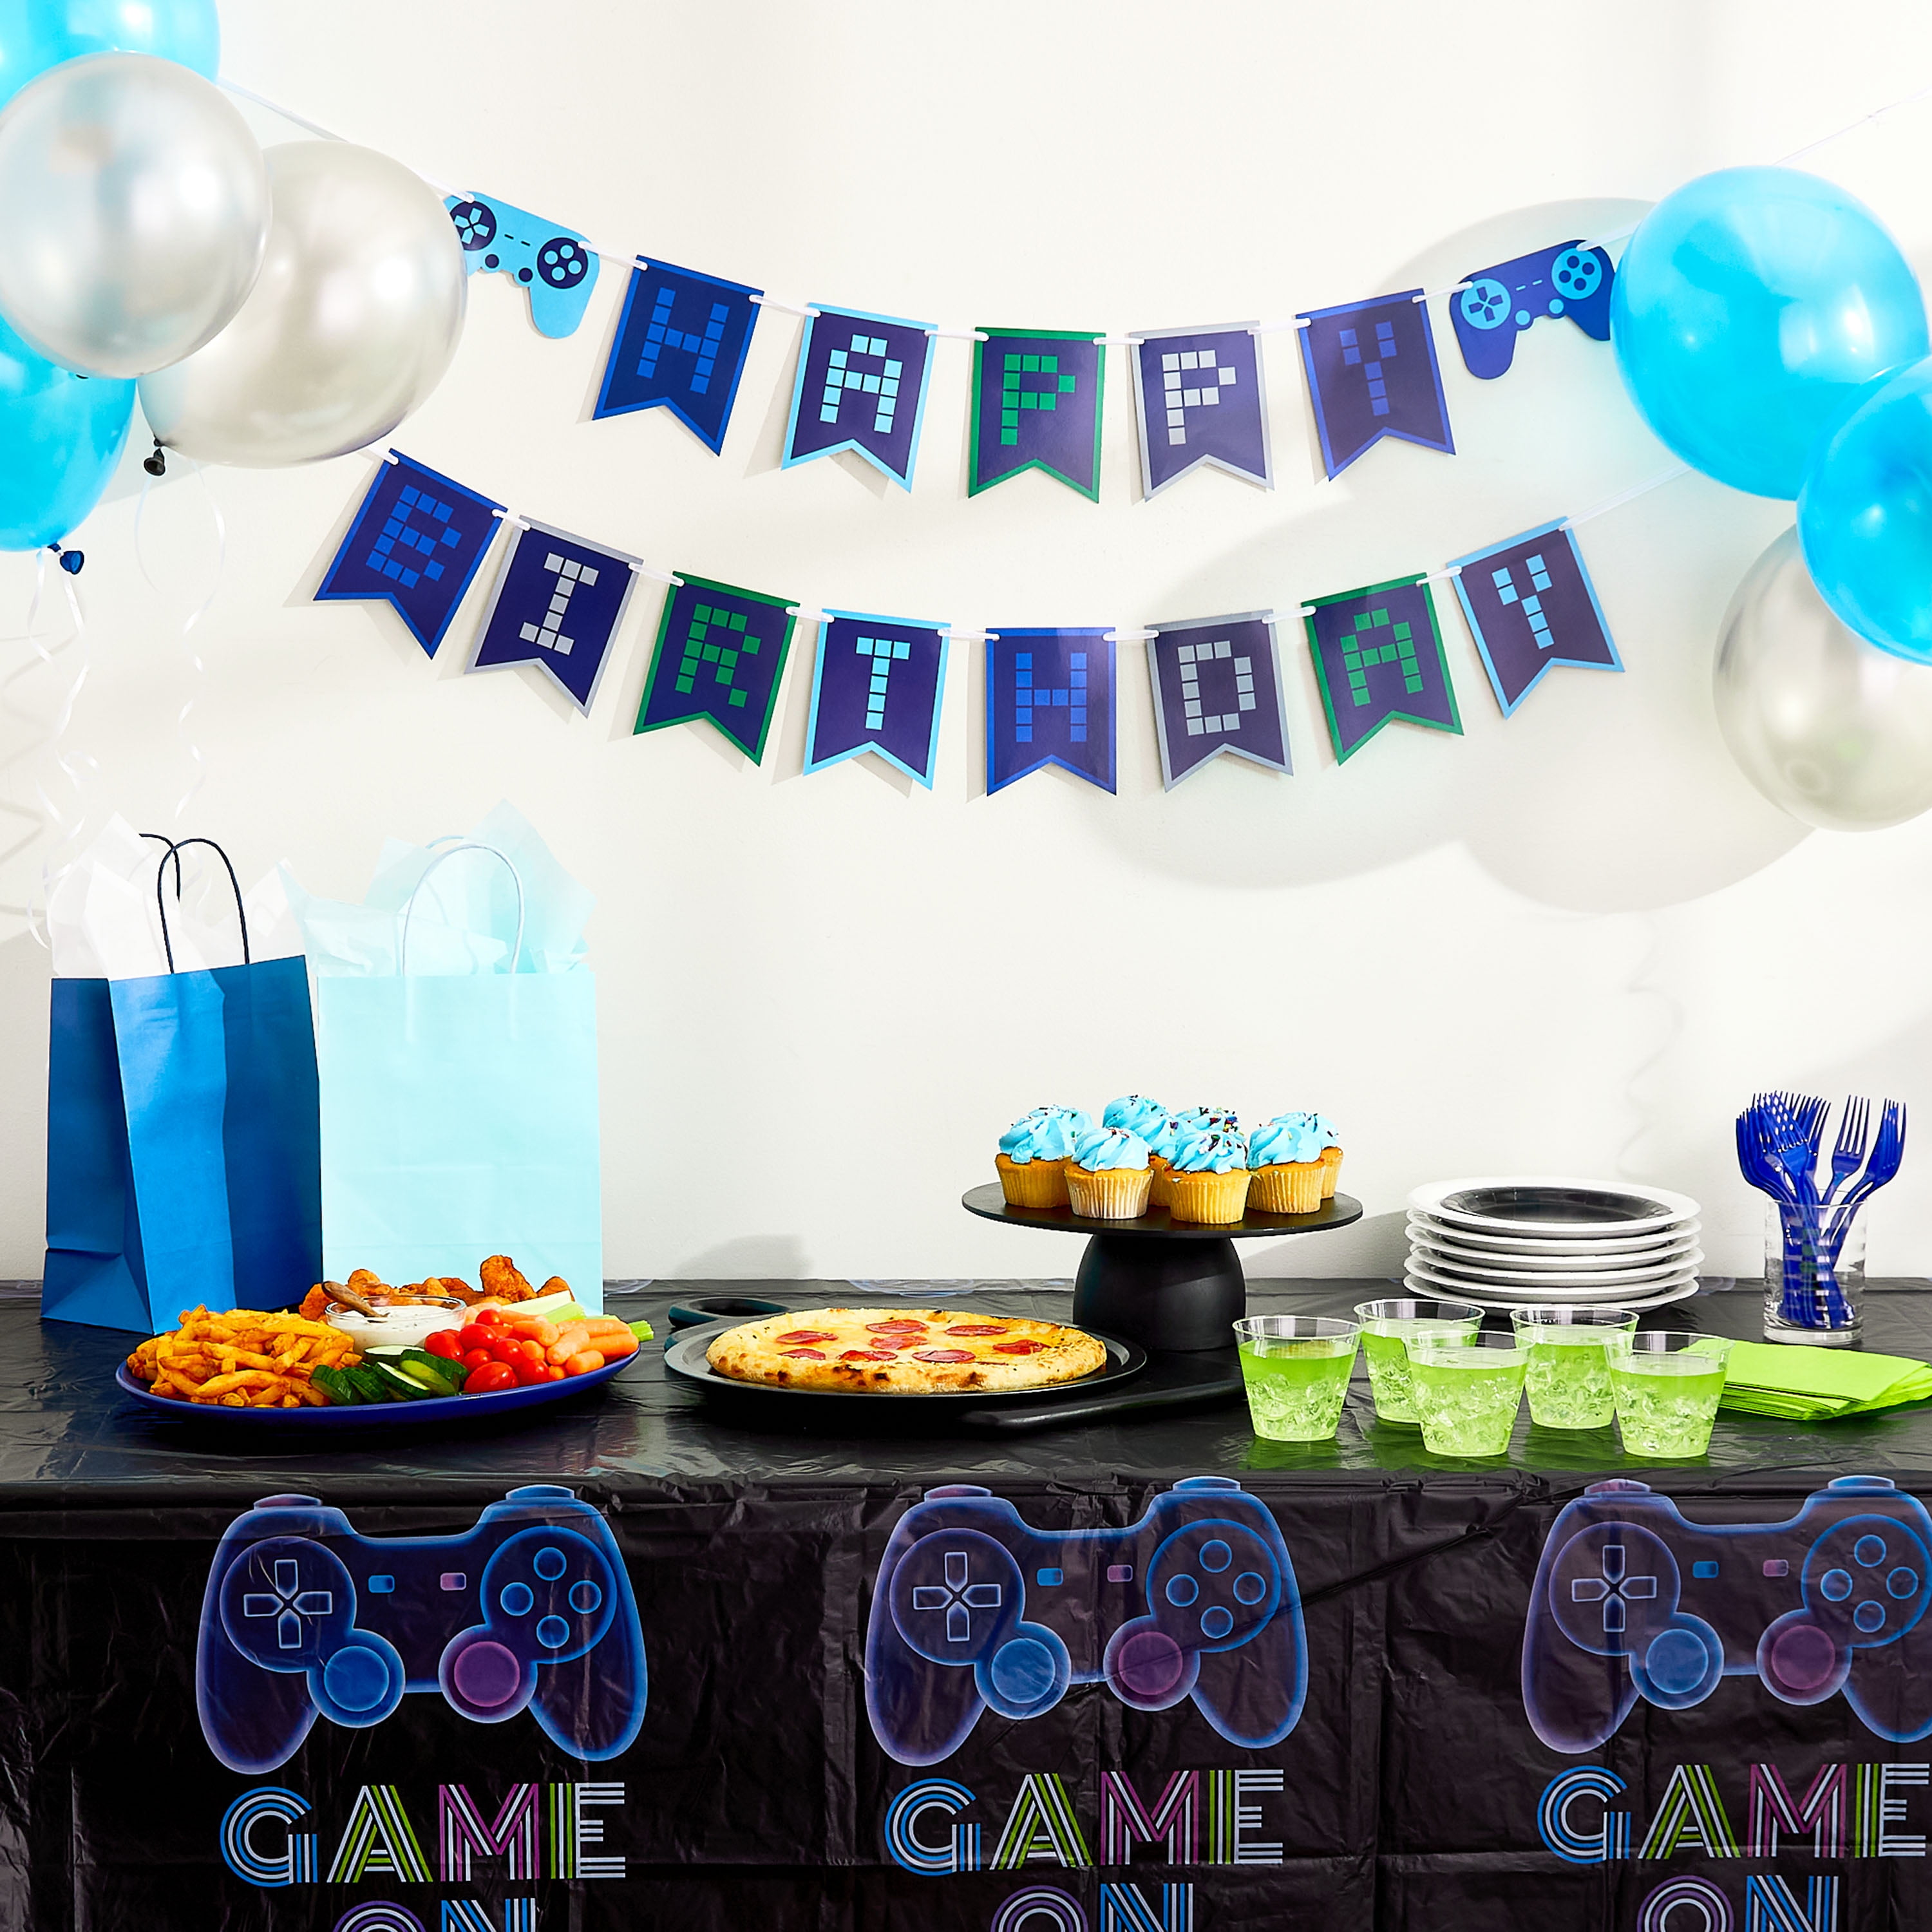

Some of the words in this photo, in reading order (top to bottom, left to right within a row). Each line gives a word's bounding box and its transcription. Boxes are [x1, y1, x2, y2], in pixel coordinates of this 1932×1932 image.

[636, 287, 1397, 446] HAPPY
[366, 485, 1555, 743] BIRTHDAY
[220, 1782, 625, 1887] GAME
[884, 1769, 1284, 1877] GAME
[1537, 1763, 1930, 1864] GAME
